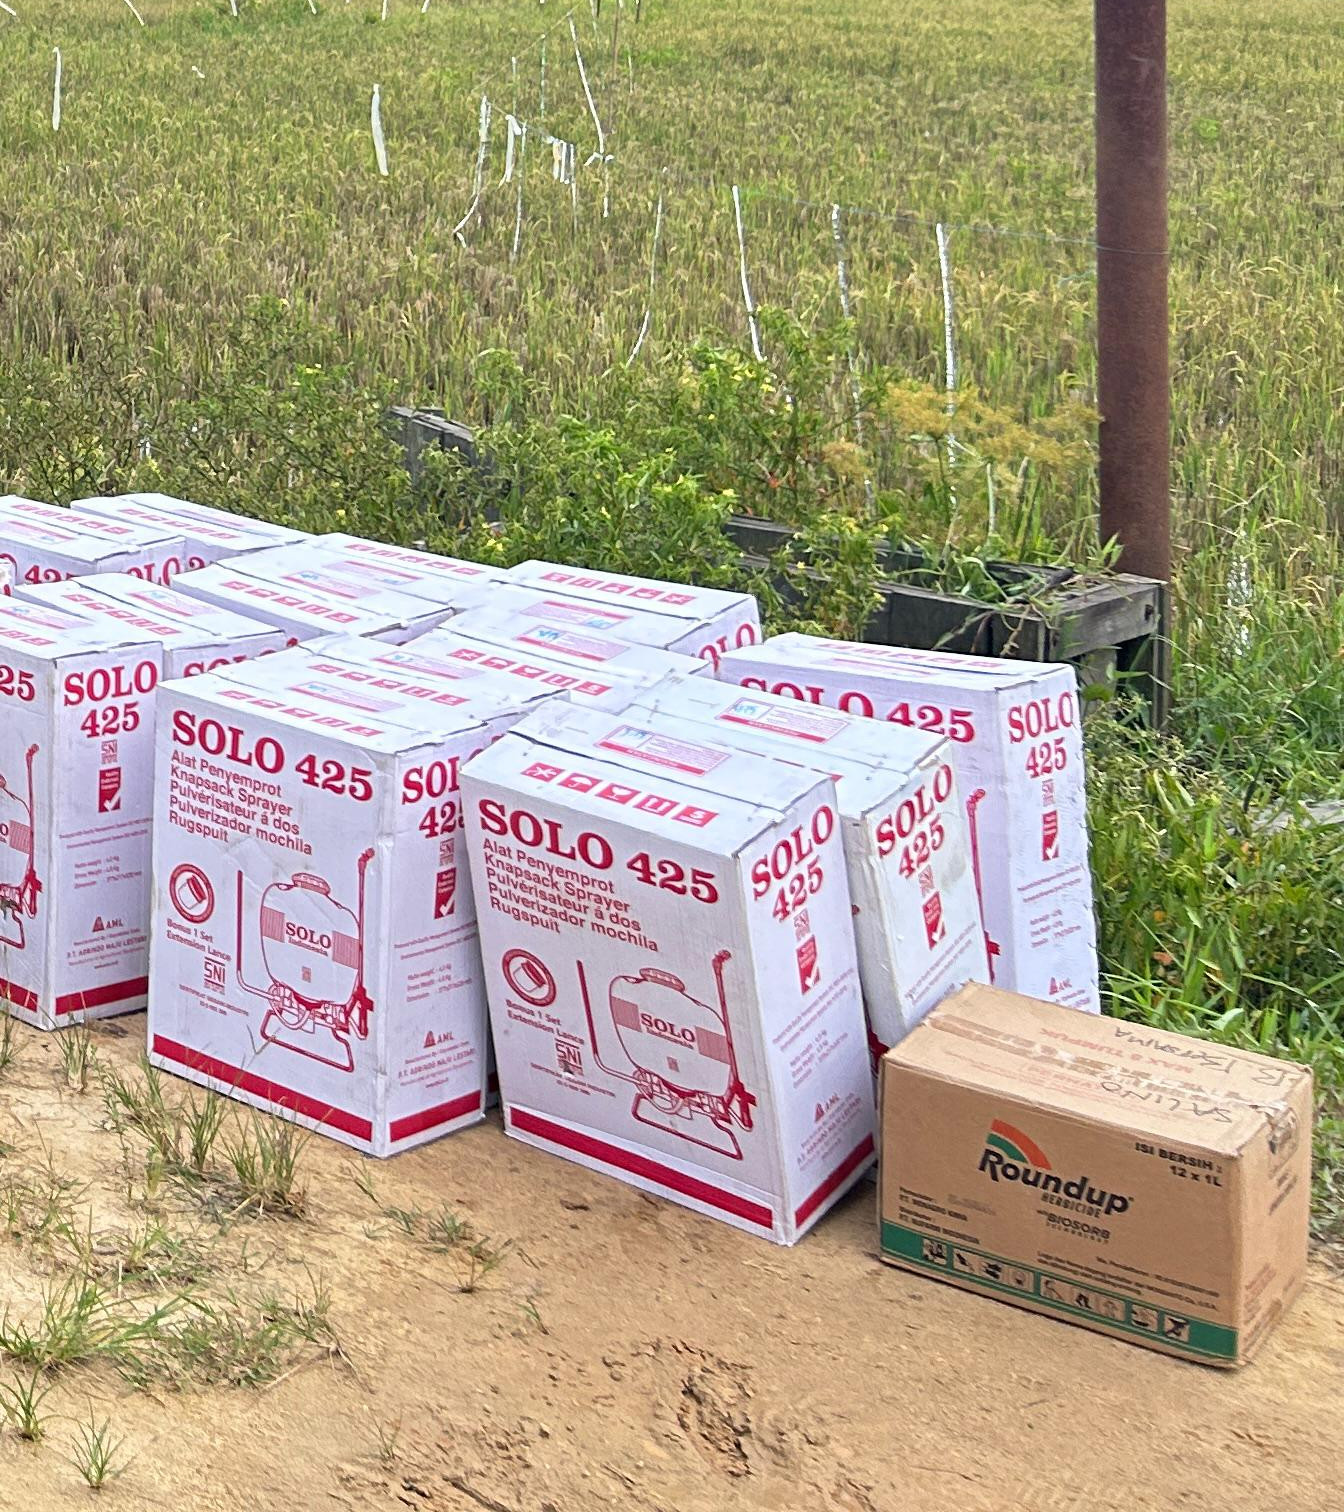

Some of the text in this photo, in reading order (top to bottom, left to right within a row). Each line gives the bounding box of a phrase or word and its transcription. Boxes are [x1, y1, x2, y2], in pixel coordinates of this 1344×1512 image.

[64, 660, 158, 707] SOLO
[80, 701, 140, 739] 425
[1007, 691, 1074, 744] SOLO
[172, 709, 373, 801] SOLO 425
[172, 749, 282, 798] Alat Penyemprot
[1025, 737, 1068, 779] 425
[170, 764, 293, 817] Knapsack Sprayer
[402, 756, 460, 805] SOL
[169, 810, 229, 843] Rugspuit
[170, 780, 257, 820] Pulvérisateur
[273, 815, 300, 835] dos
[170, 795, 251, 835] Pulverizador
[256, 828, 313, 856] mochila
[876, 763, 953, 859] SOLO
[479, 798, 719, 905] SOLO 425
[483, 838, 615, 894] Alat Penyemprot
[751, 804, 834, 902] SOLO
[898, 813, 945, 879] 425
[484, 852, 631, 914] Knapsack Sprayer
[487, 868, 590, 915] Pulvérisateur
[609, 910, 642, 932] dos
[772, 854, 824, 923] 425
[285, 922, 332, 949] SOLO
[489, 882, 659, 953] Pulverizador mochila
[491, 896, 560, 934] Rugspuit
[204, 960, 226, 985] SNI
[545, 1012, 561, 1026] Set
[640, 1012, 696, 1043] SOLO
[555, 1041, 583, 1067] SNI
[1135, 1142, 1154, 1155] ISI
[1158, 1148, 1213, 1171] BERSIH
[1170, 1165, 1187, 1178] 12
[1190, 1173, 1199, 1182] x
[978, 1148, 1131, 1216] Roundup
[1040, 1191, 1102, 1219] HERBICIDE
[1047, 1213, 1111, 1240] BIOSORB
